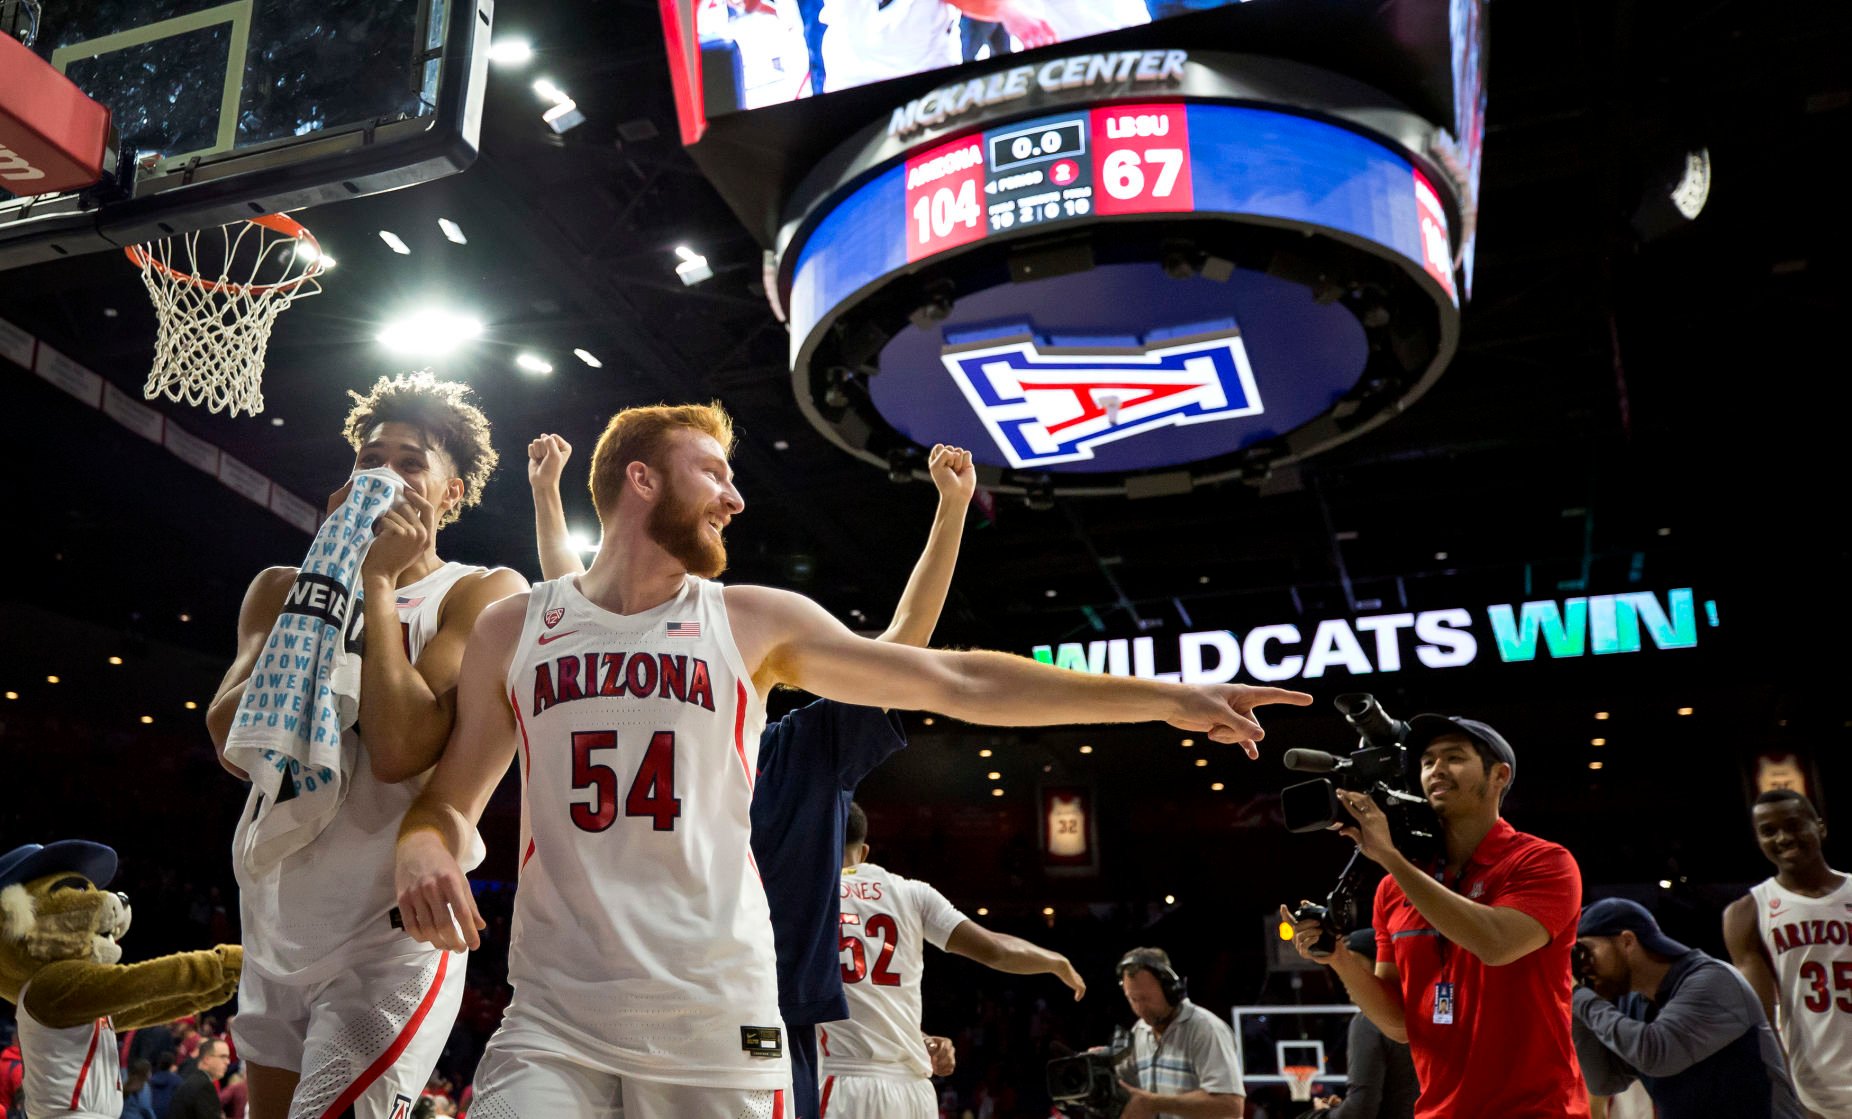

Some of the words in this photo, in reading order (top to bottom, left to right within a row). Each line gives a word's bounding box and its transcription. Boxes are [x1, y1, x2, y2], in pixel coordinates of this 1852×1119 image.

[1037, 49, 1188, 92] CENTER
[1011, 131, 1062, 160] 0.0
[1102, 148, 1184, 201] 67
[913, 179, 981, 244] 104
[1487, 587, 1698, 662] WIN
[532, 652, 716, 717] ARIZONA
[569, 729, 682, 833] 54
[840, 881, 882, 901] ONES
[838, 912, 902, 987] 52
[1800, 960, 1852, 1014] 35
